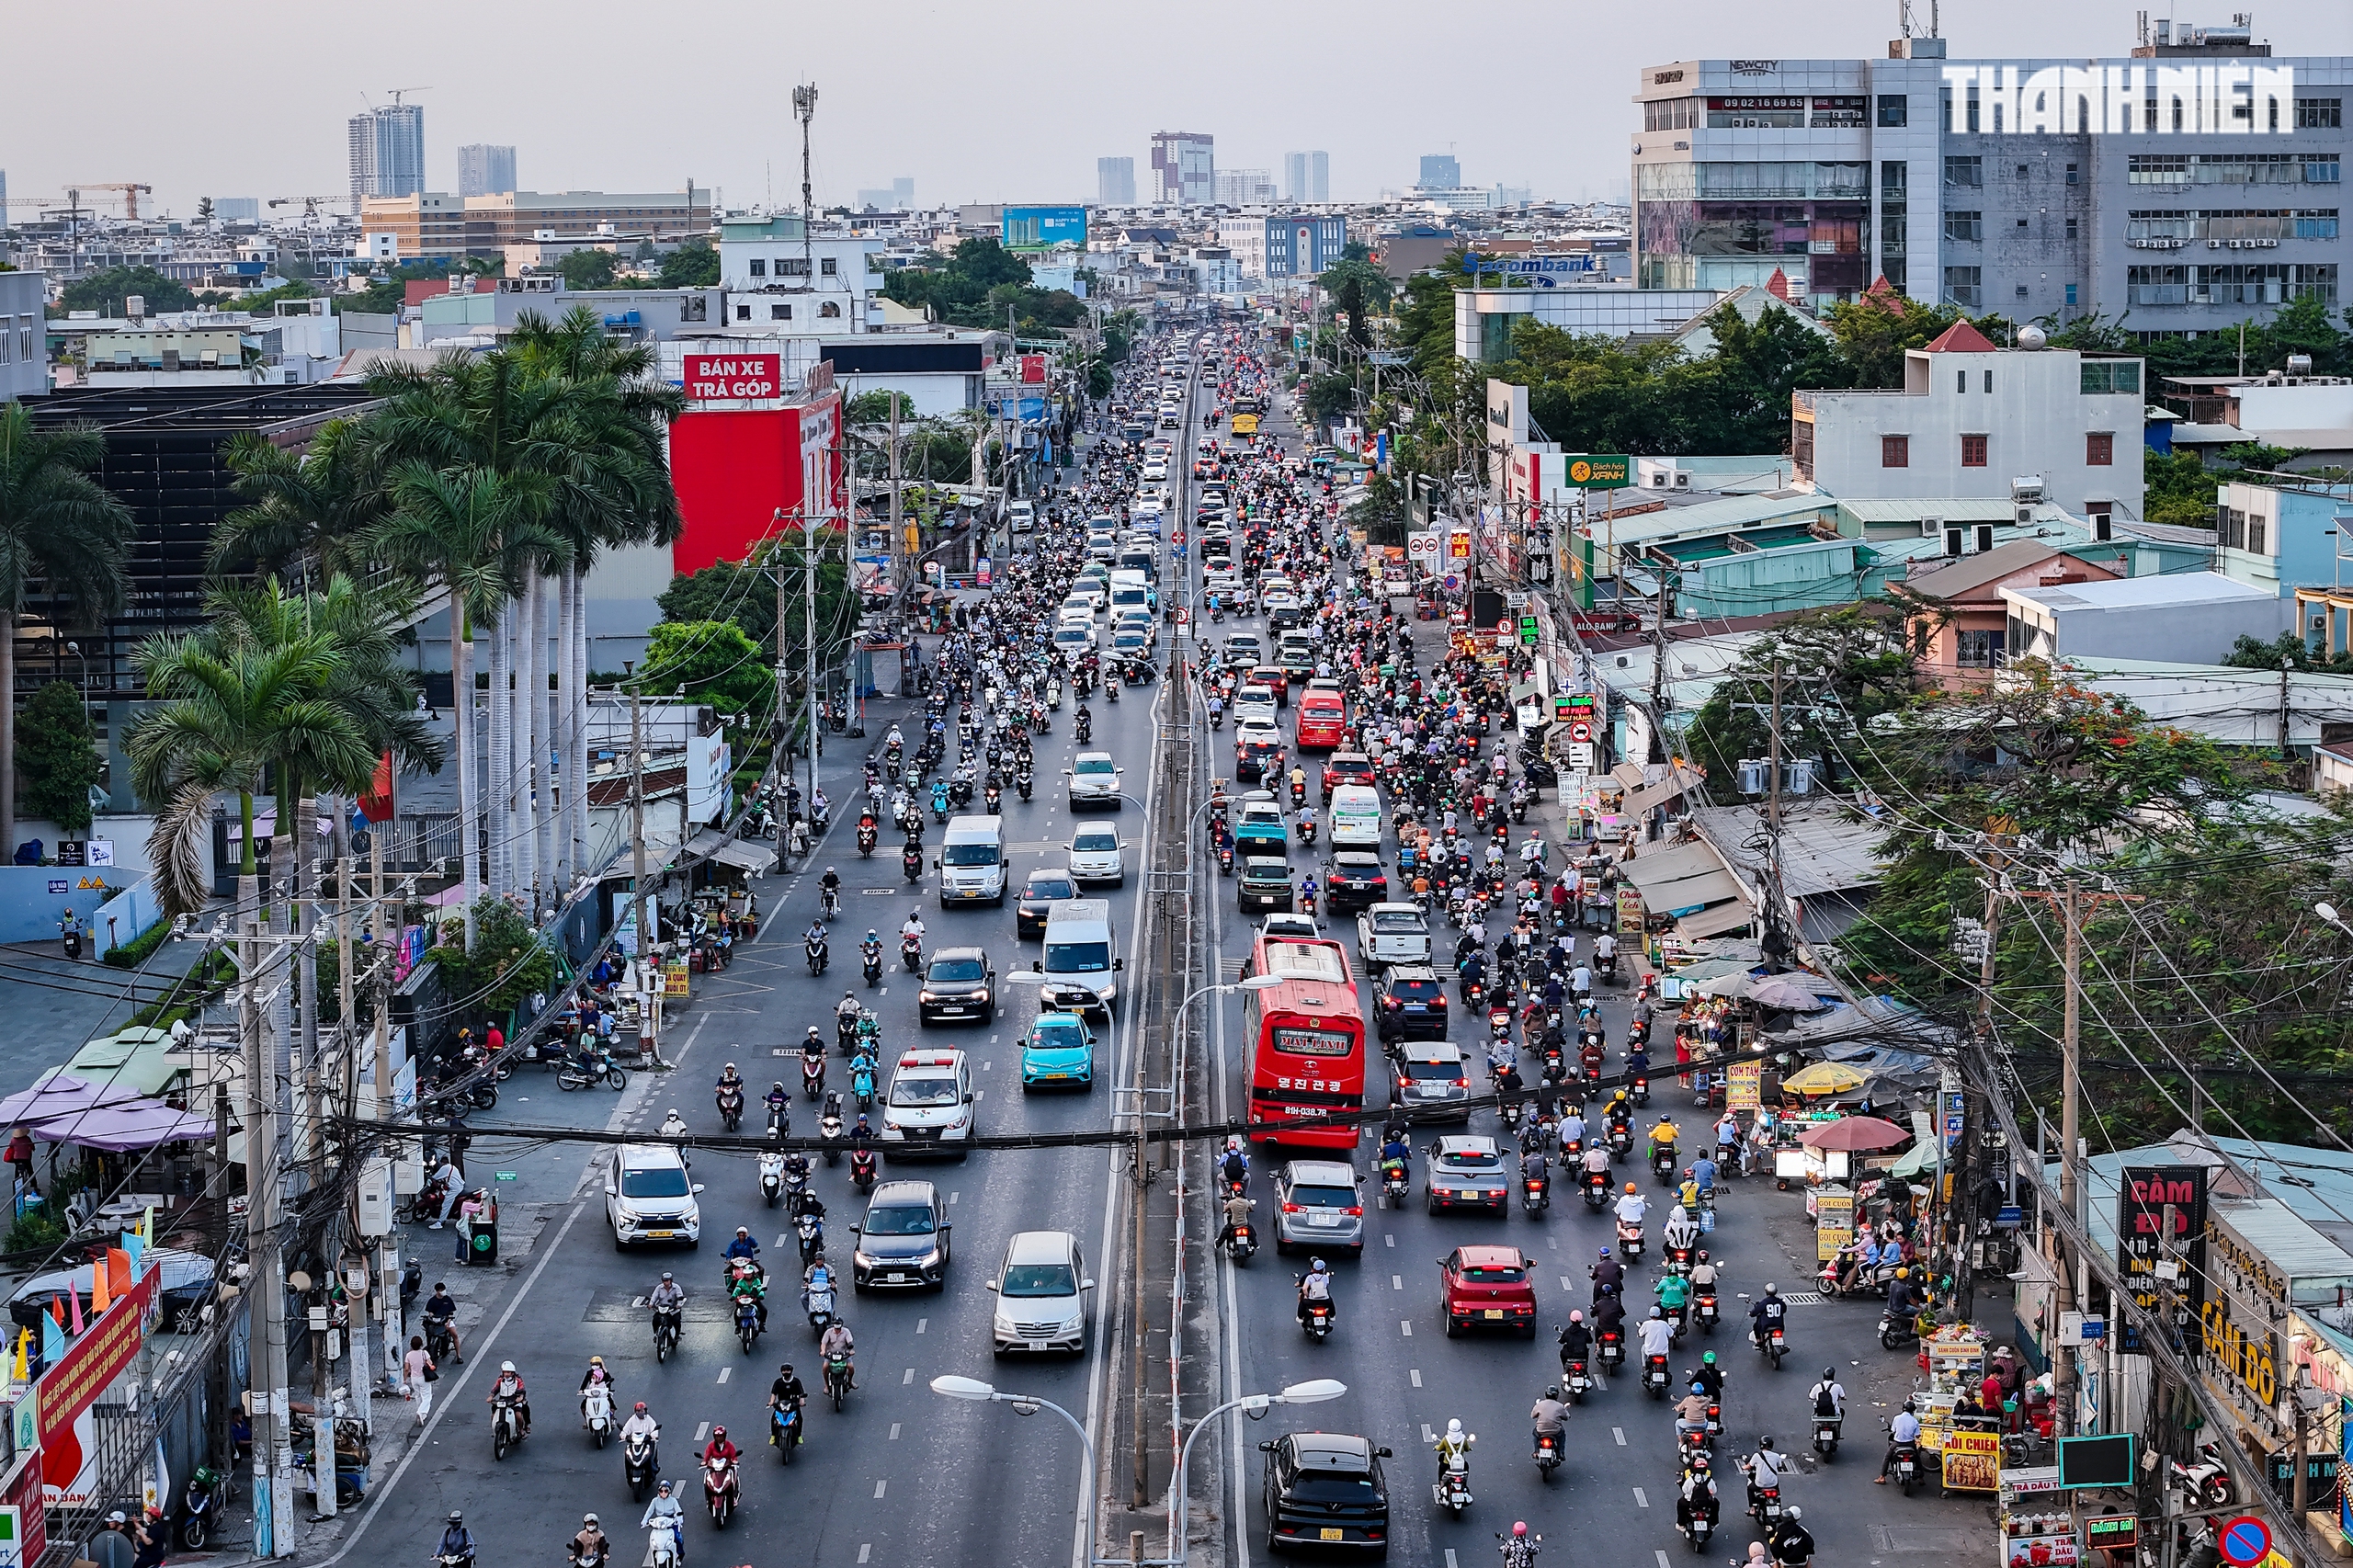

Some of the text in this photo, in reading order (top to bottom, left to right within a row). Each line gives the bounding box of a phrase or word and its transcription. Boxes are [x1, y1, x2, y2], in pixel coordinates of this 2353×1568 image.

[1462, 252, 1595, 273] Sacombank
[699, 358, 765, 376] BÁN XE
[693, 379, 772, 397] TRẢ GÓP
[1592, 462, 1611, 471] Bách
[1591, 471, 1624, 480] XANH
[1556, 696, 1592, 706] NHÀ THUỐC
[1571, 706, 1590, 714] PHẨM
[1620, 890, 1643, 899] Cháo
[1623, 899, 1639, 909] Ếch
[1280, 1037, 1346, 1050] MAI LINH
[1285, 1107, 1326, 1117] 81H-038.78
[2131, 1173, 2193, 1203] CẦM
[2134, 1209, 2188, 1233] ĐỒ
[2137, 1236, 2148, 1254] TÔ
[2131, 1256, 2153, 1272] NHÀ
[2212, 1255, 2226, 1280] MUA
[2225, 1266, 2239, 1291] BÁN
[2129, 1275, 2154, 1291] ĐIỆN
[1766, 1303, 1780, 1318] 90
[2201, 1287, 2240, 1377] CẦM
[2245, 1327, 2274, 1406] ĐỒ
[1966, 1437, 1996, 1451] CHIÊN
[2013, 1483, 2029, 1492] TRÀ
[2031, 1481, 2051, 1491] DÂU
[62, 1493, 85, 1502] DÂN
[2091, 1517, 2133, 1534] BÁNH MÌ
[2054, 1538, 2072, 1546] TRÀ
[2055, 1547, 2073, 1556] DÂU
